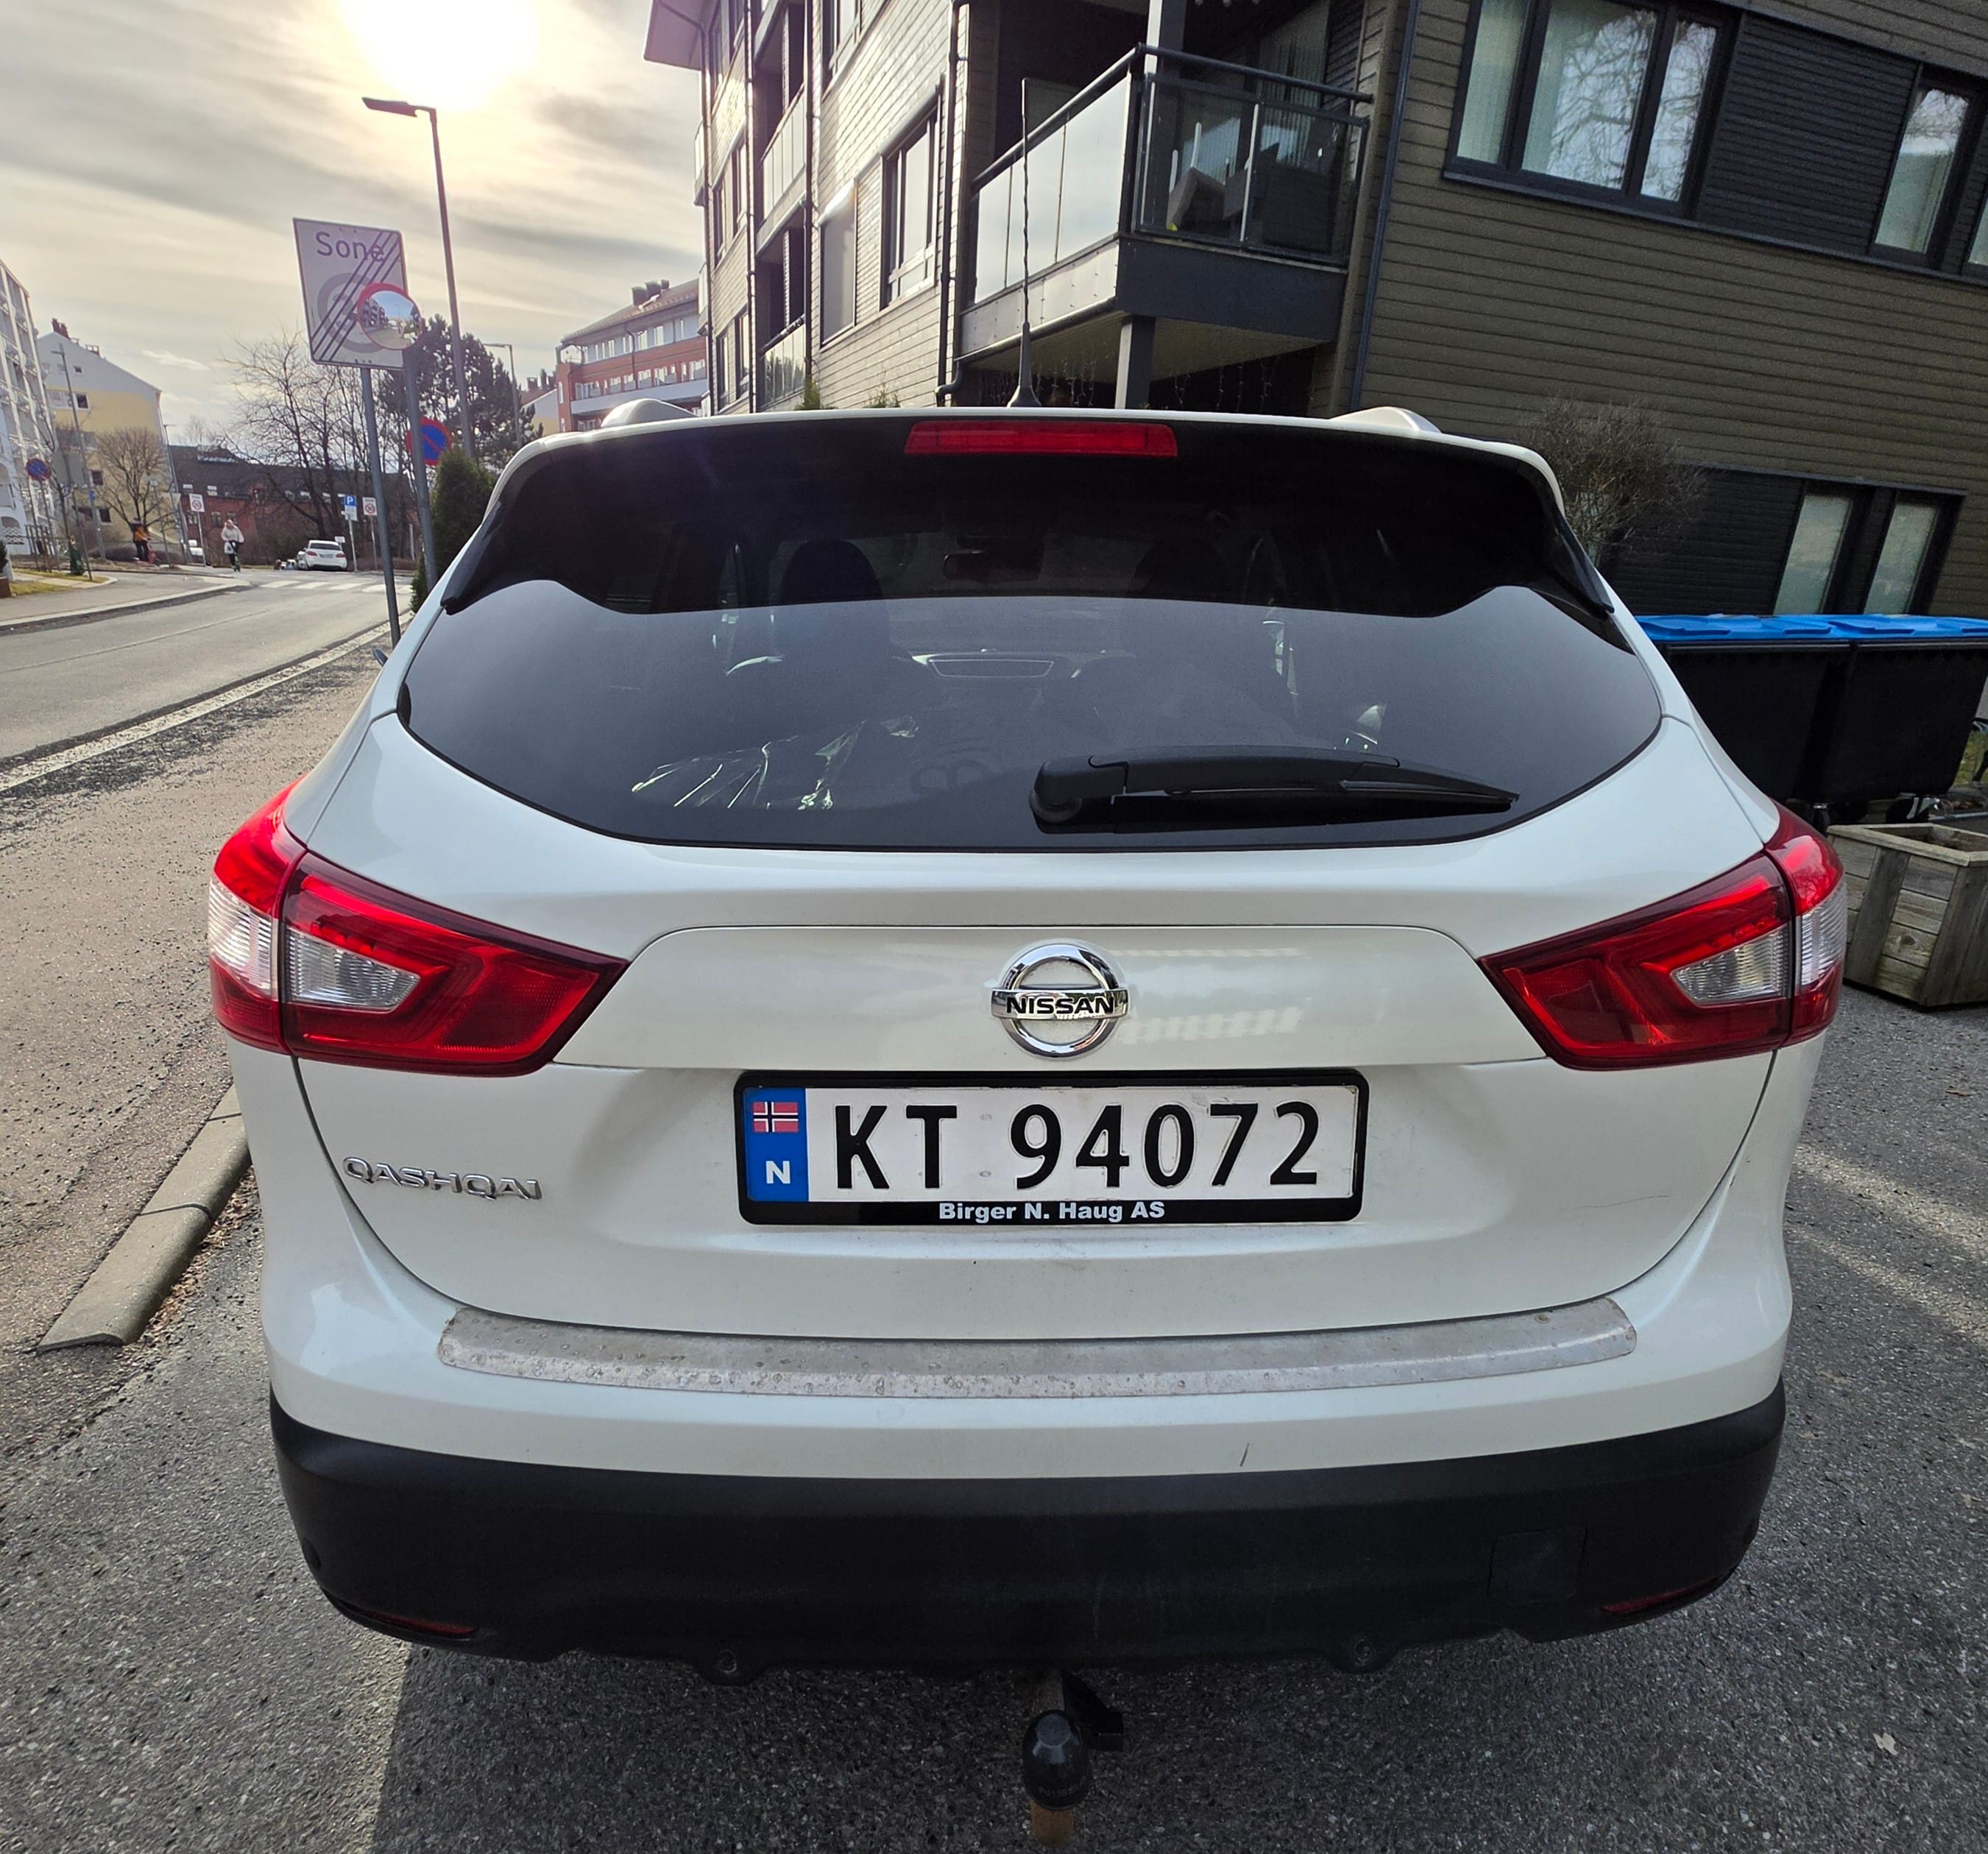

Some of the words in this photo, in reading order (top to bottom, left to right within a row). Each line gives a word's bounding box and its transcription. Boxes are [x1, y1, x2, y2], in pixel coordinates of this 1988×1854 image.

[316, 231, 384, 262] Sone
[347, 496, 354, 505] P
[1006, 997, 1114, 1014] NISSAN
[835, 1105, 958, 1189] KT
[1011, 1101, 1320, 1189] 94072
[343, 1156, 542, 1200] QASHQAI
[765, 1161, 791, 1184] N
[939, 1203, 1016, 1223] Birger
[1025, 1203, 1050, 1219] N.
[1059, 1202, 1123, 1223] Haug
[1131, 1201, 1166, 1218] AS
